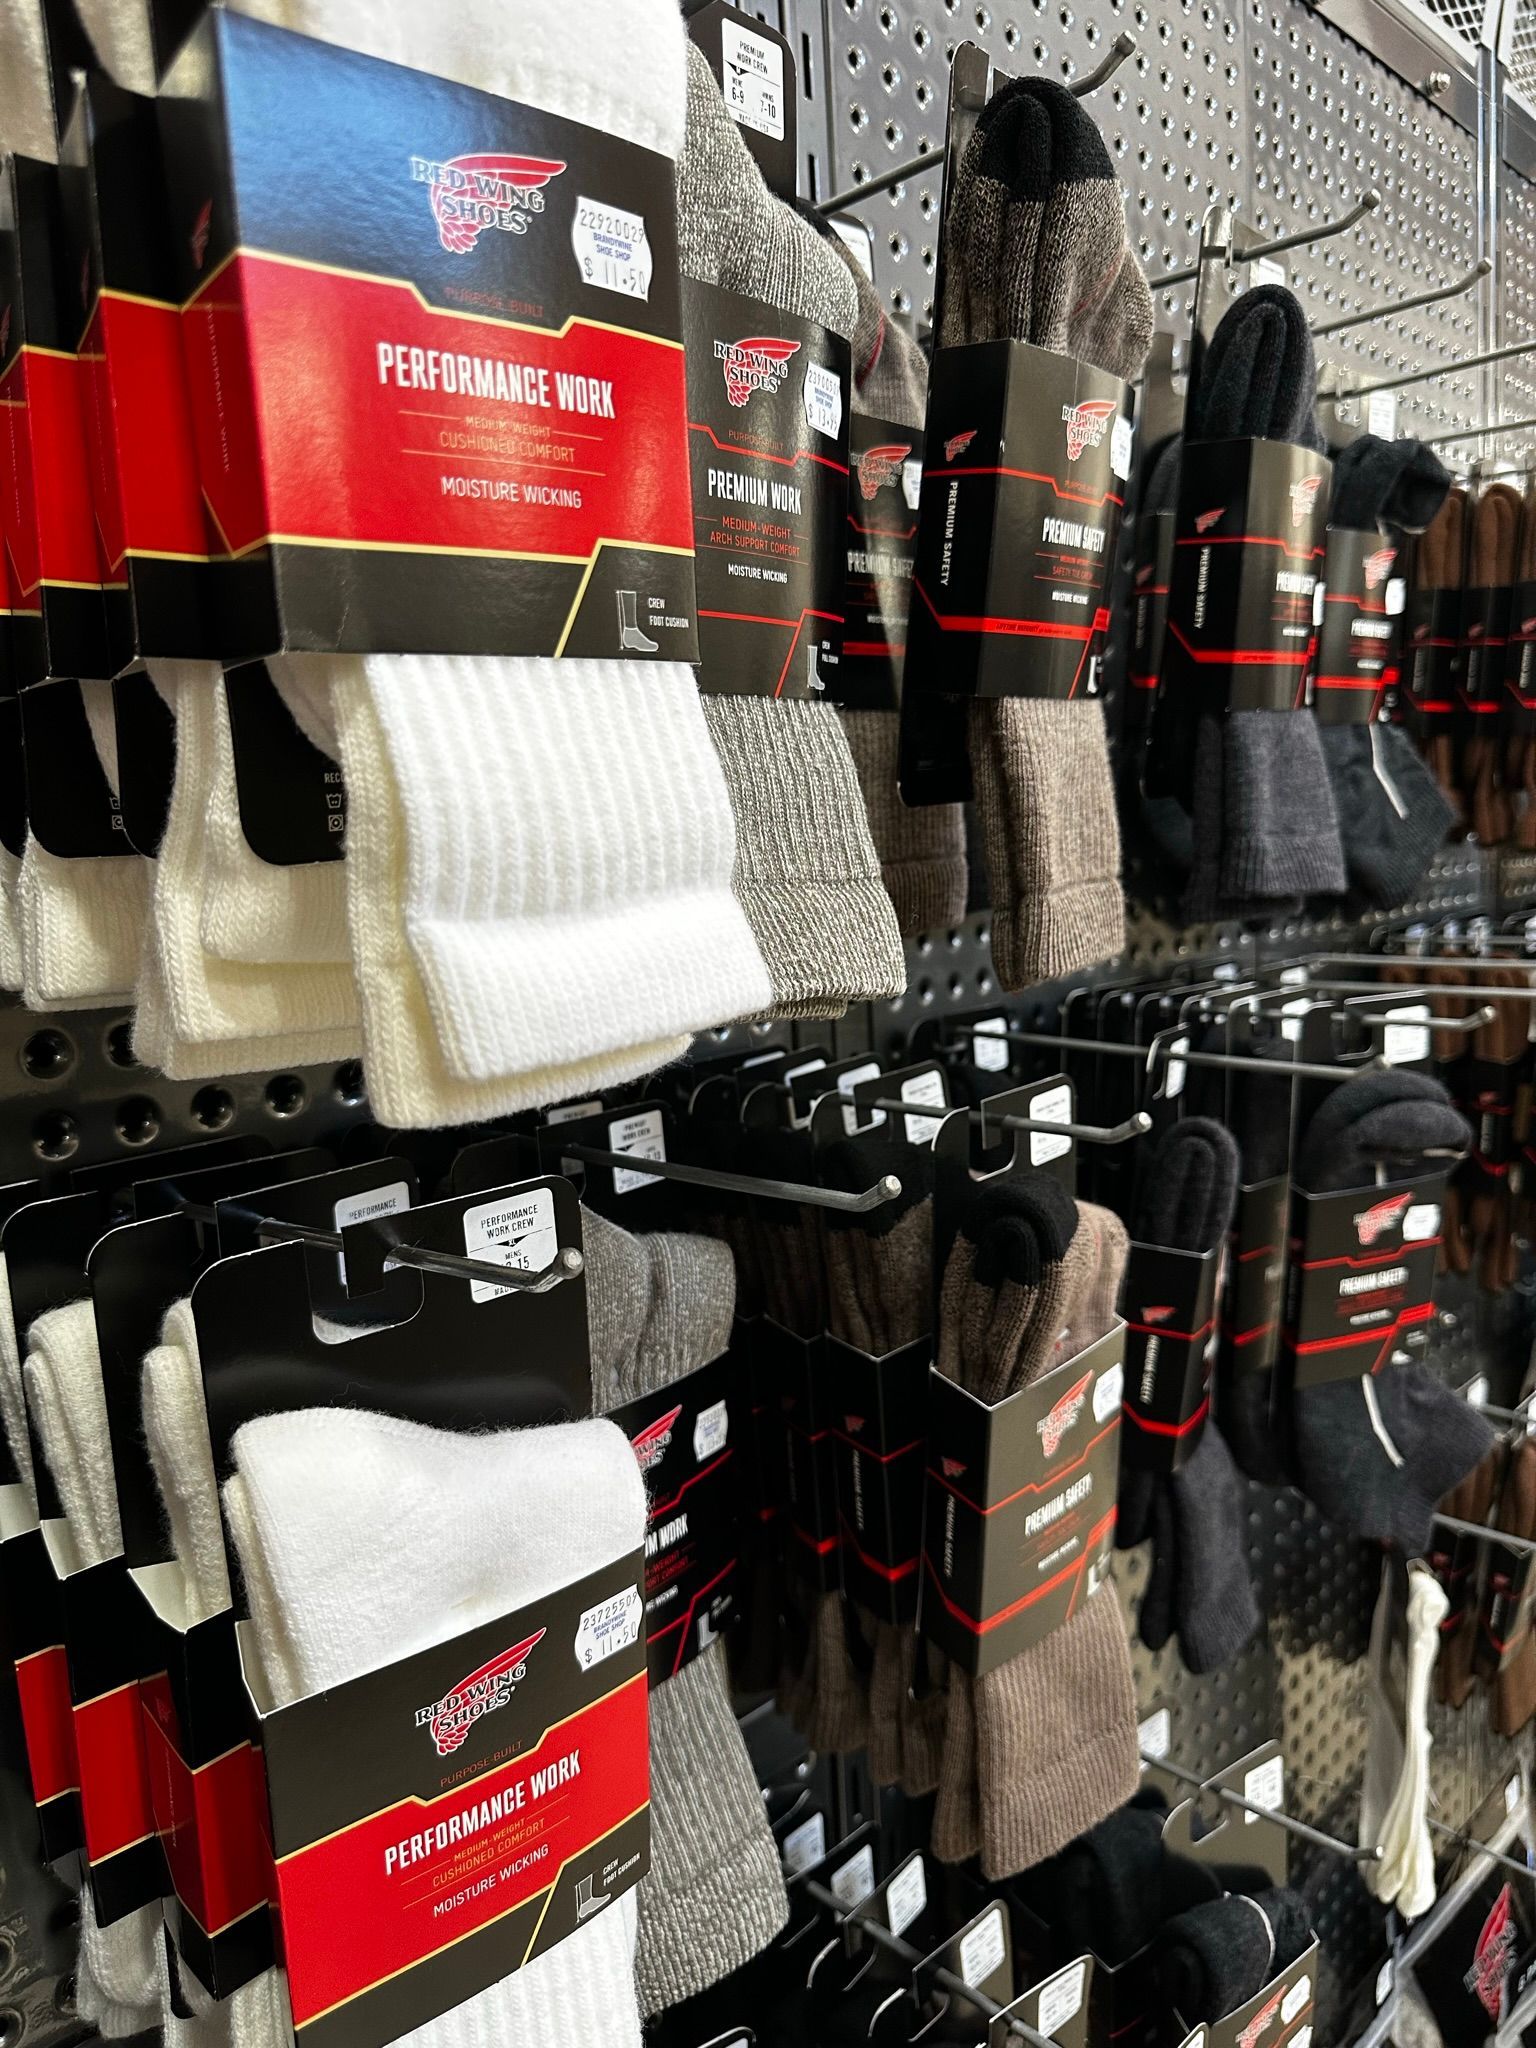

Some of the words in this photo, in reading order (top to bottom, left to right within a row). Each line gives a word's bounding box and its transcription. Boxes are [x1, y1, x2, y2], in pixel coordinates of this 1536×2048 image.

[740, 40, 765, 60] PREMIUM
[752, 60, 768, 74] CREW
[731, 87, 744, 104] 6-9
[760, 100, 776, 119] 7-10
[410, 156, 466, 190] RED
[474, 173, 546, 214] WING
[440, 194, 529, 236] SHOES
[580, 208, 645, 244] 22920029
[593, 232, 632, 252] BRANDYWINE
[596, 244, 614, 258] SHOE
[614, 250, 631, 262] SHOP
[584, 256, 594, 279] $
[604, 259, 646, 295] 11.50
[714, 340, 744, 362] RED
[749, 352, 789, 379] WING
[376, 341, 551, 408] PERFORMANCE
[555, 371, 616, 420] WORK
[730, 366, 778, 394] SHOES
[1062, 405, 1082, 422] RED
[439, 430, 517, 455] CUSHIONED
[519, 440, 576, 463] COMFORT
[1070, 426, 1102, 448] SHOES
[440, 475, 520, 502] MOISTURE
[523, 486, 582, 510] WICKING
[708, 468, 768, 508] PREMIUM
[770, 481, 802, 515] WORK
[945, 480, 960, 540] PREMIUM
[710, 530, 732, 545] ARCH
[735, 535, 768, 552] SUPPORT
[770, 542, 800, 557] COMFORT
[722, 516, 791, 540] MEDIUM-WEIGHT
[1042, 516, 1083, 548] PREMIUM
[728, 563, 762, 580] MOISTURE
[762, 570, 788, 584] WICKING
[847, 552, 892, 575] PREMIUM
[940, 541, 952, 586] SAFETY
[648, 597, 666, 610] CREW
[649, 615, 664, 627] FOOT
[665, 616, 690, 628] CUSHION
[349, 1198, 397, 1220] PERFORMANCE
[480, 1204, 539, 1229] PERFORMANCE
[486, 1225, 511, 1240] WORK
[512, 1216, 534, 1232] CREW
[505, 1249, 522, 1260] MENS
[1025, 1492, 1065, 1537] PREMIUM
[1065, 1472, 1093, 1510] SAFETY
[658, 1513, 688, 1551] WORK
[583, 1591, 638, 1631] 23725509
[593, 1610, 626, 1634] BRANDYWINE
[584, 1648, 592, 1664] $
[602, 1621, 637, 1656] 11.50
[596, 1627, 610, 1640] SHOE
[611, 1618, 626, 1631] SHOP
[415, 1694, 461, 1726] RED
[466, 1662, 526, 1702] WING
[439, 1689, 511, 1732] SHOES
[440, 1740, 522, 1788] PURPOSE-BUILT
[384, 1780, 526, 1876] PERFORMANCE
[530, 1748, 581, 1800] WORK
[432, 1847, 494, 1887] CUSHIONED
[497, 1818, 545, 1852] COMFORT
[453, 1818, 526, 1862] MEDIUM-WEIGHT
[433, 1874, 497, 1918] MOISTURE
[499, 1844, 550, 1882] WICKING
[603, 1857, 619, 1876] CREW
[604, 1870, 618, 1886] FOOT
[618, 1852, 641, 1876] CUSHION
